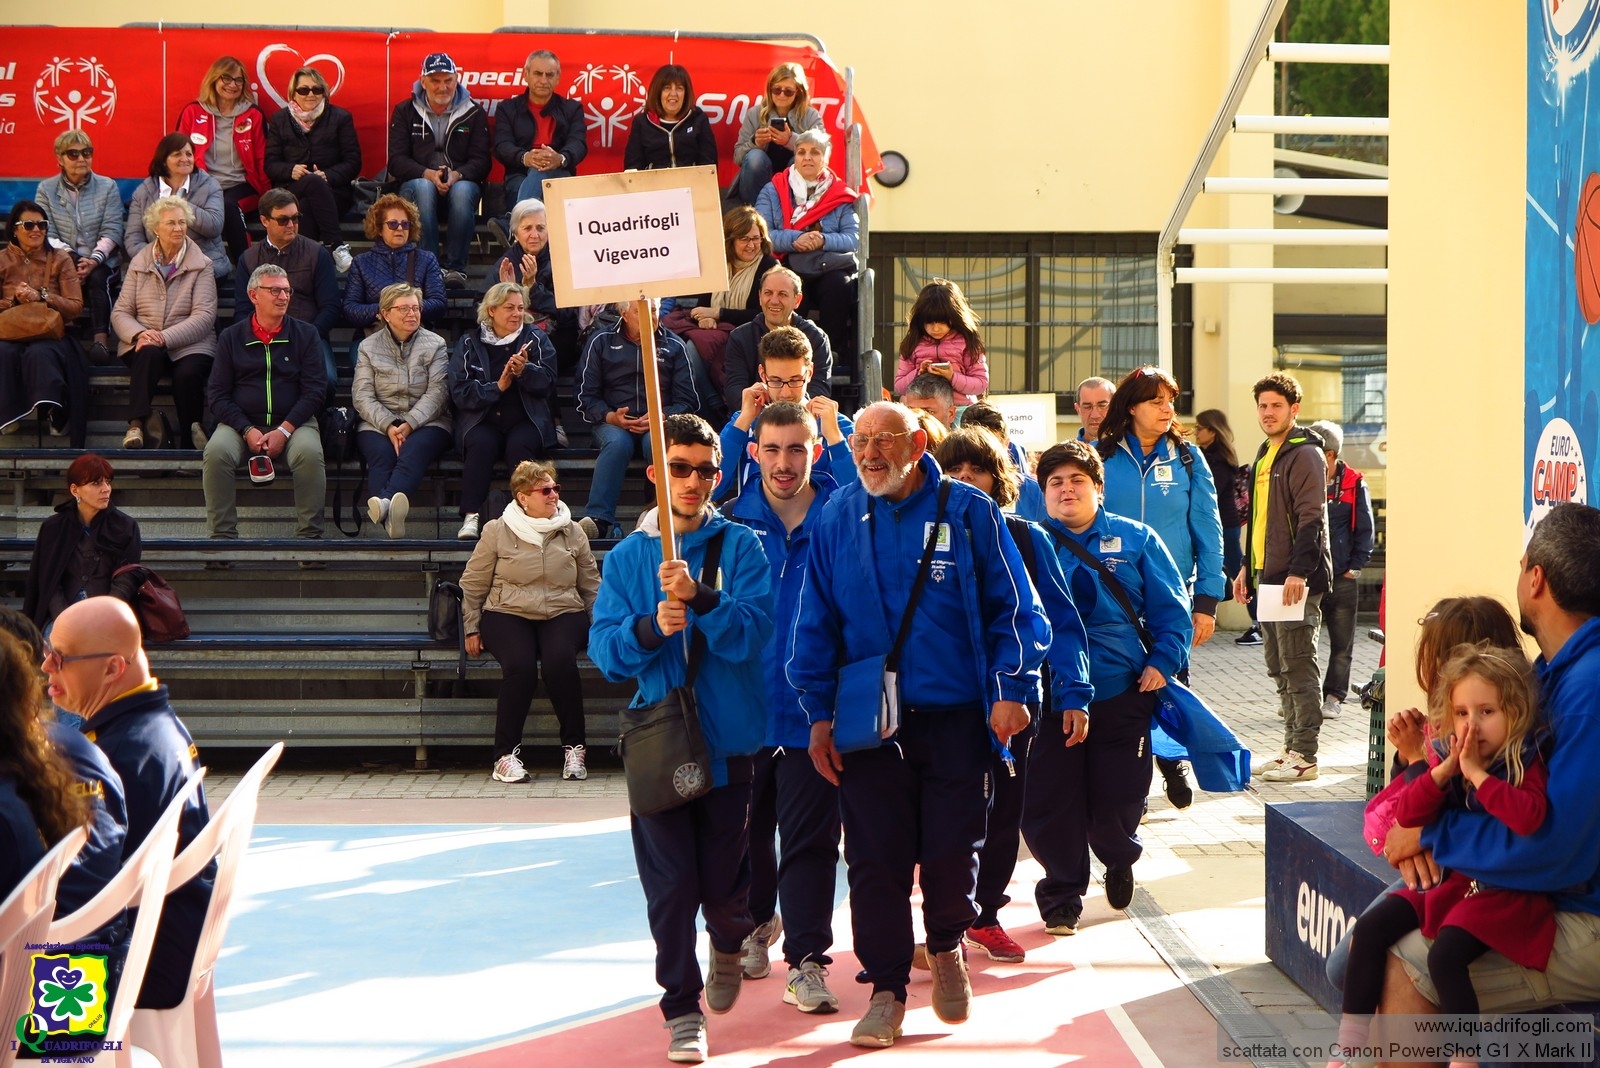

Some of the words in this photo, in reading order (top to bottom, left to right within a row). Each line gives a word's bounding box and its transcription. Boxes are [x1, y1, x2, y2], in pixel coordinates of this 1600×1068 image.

[578, 222, 583, 235] I
[588, 212, 680, 236] Quadrifogli
[594, 246, 670, 265] Vigevano
[1533, 459, 1578, 506] CAMP
